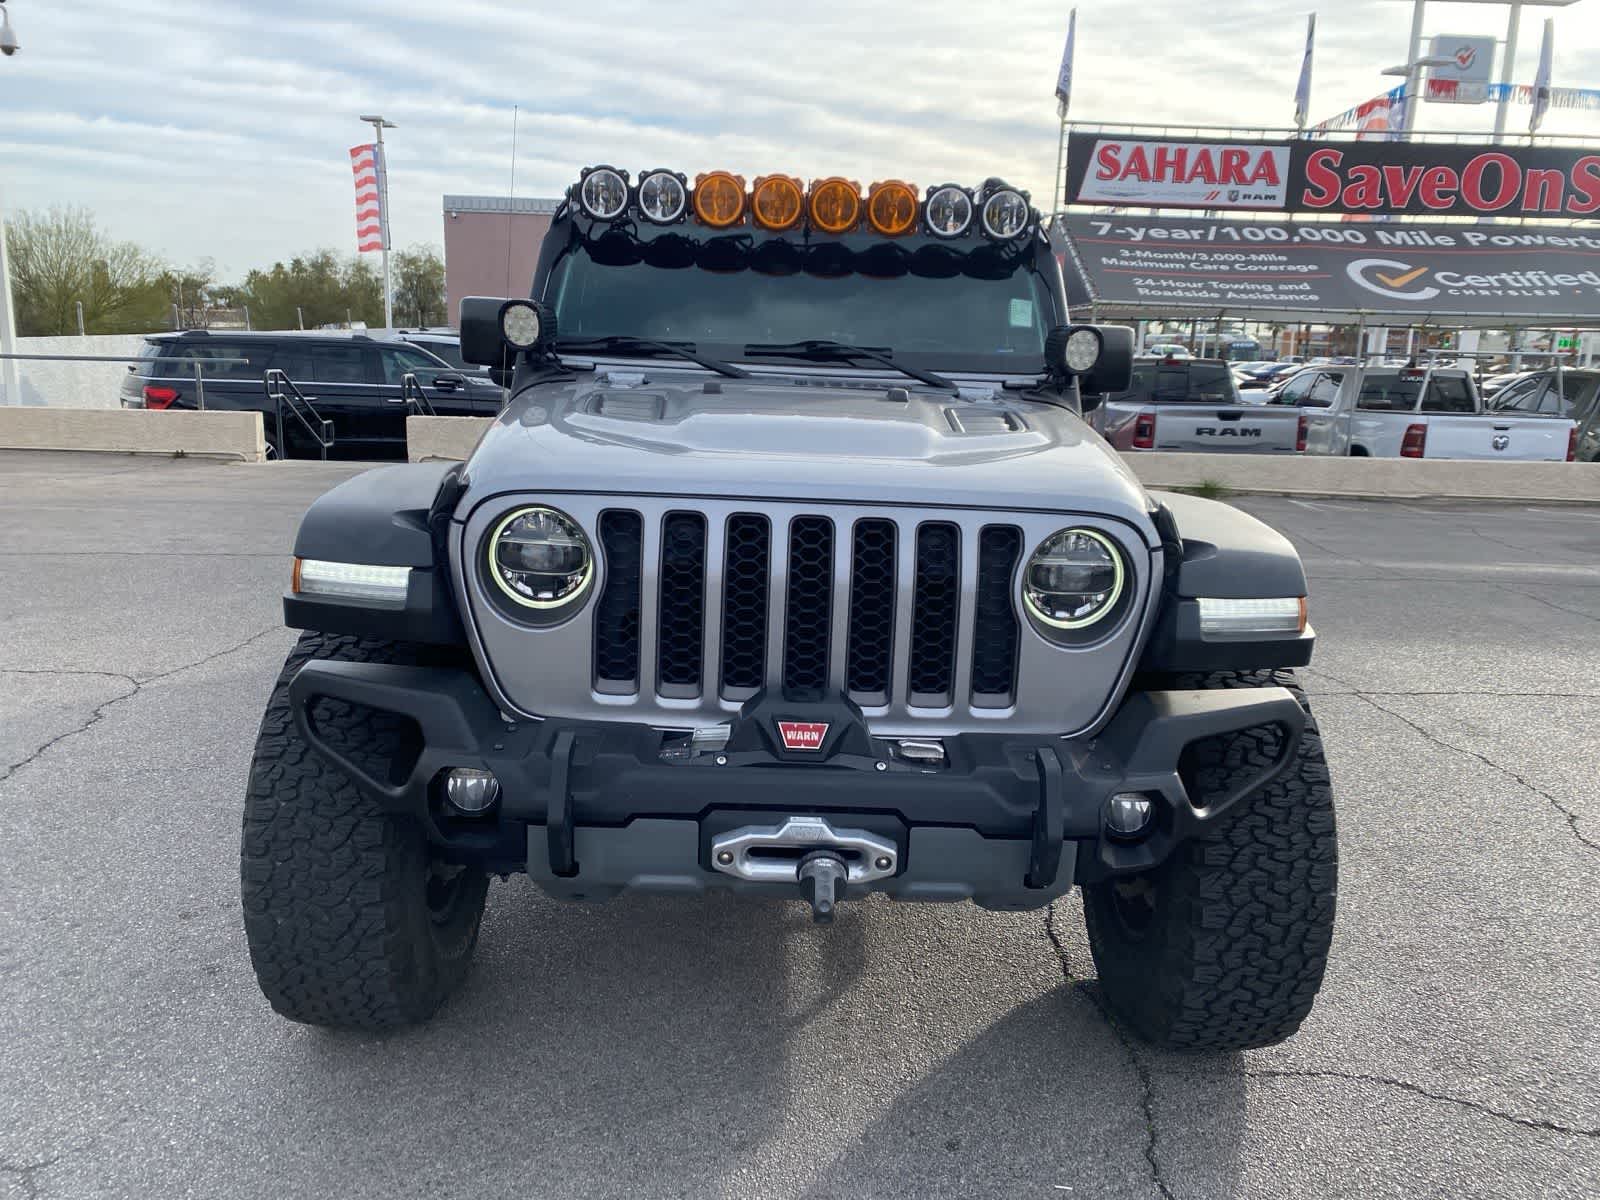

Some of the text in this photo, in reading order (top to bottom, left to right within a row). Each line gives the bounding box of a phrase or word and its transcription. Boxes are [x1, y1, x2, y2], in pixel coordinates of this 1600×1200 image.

[1096, 143, 1280, 186] SAHARA
[1242, 193, 1277, 201] RAM
[1375, 230, 1457, 246] Mile
[1101, 257, 1319, 273] Maximum Care Coverage
[1132, 278, 1312, 292] 24-Hour Towing and
[1434, 270, 1600, 287] Certified
[1137, 287, 1320, 301] Roadside Assistance
[1447, 288, 1561, 296] CHRYSLER
[1195, 427, 1262, 437] RAM
[786, 730, 819, 741] WARN
